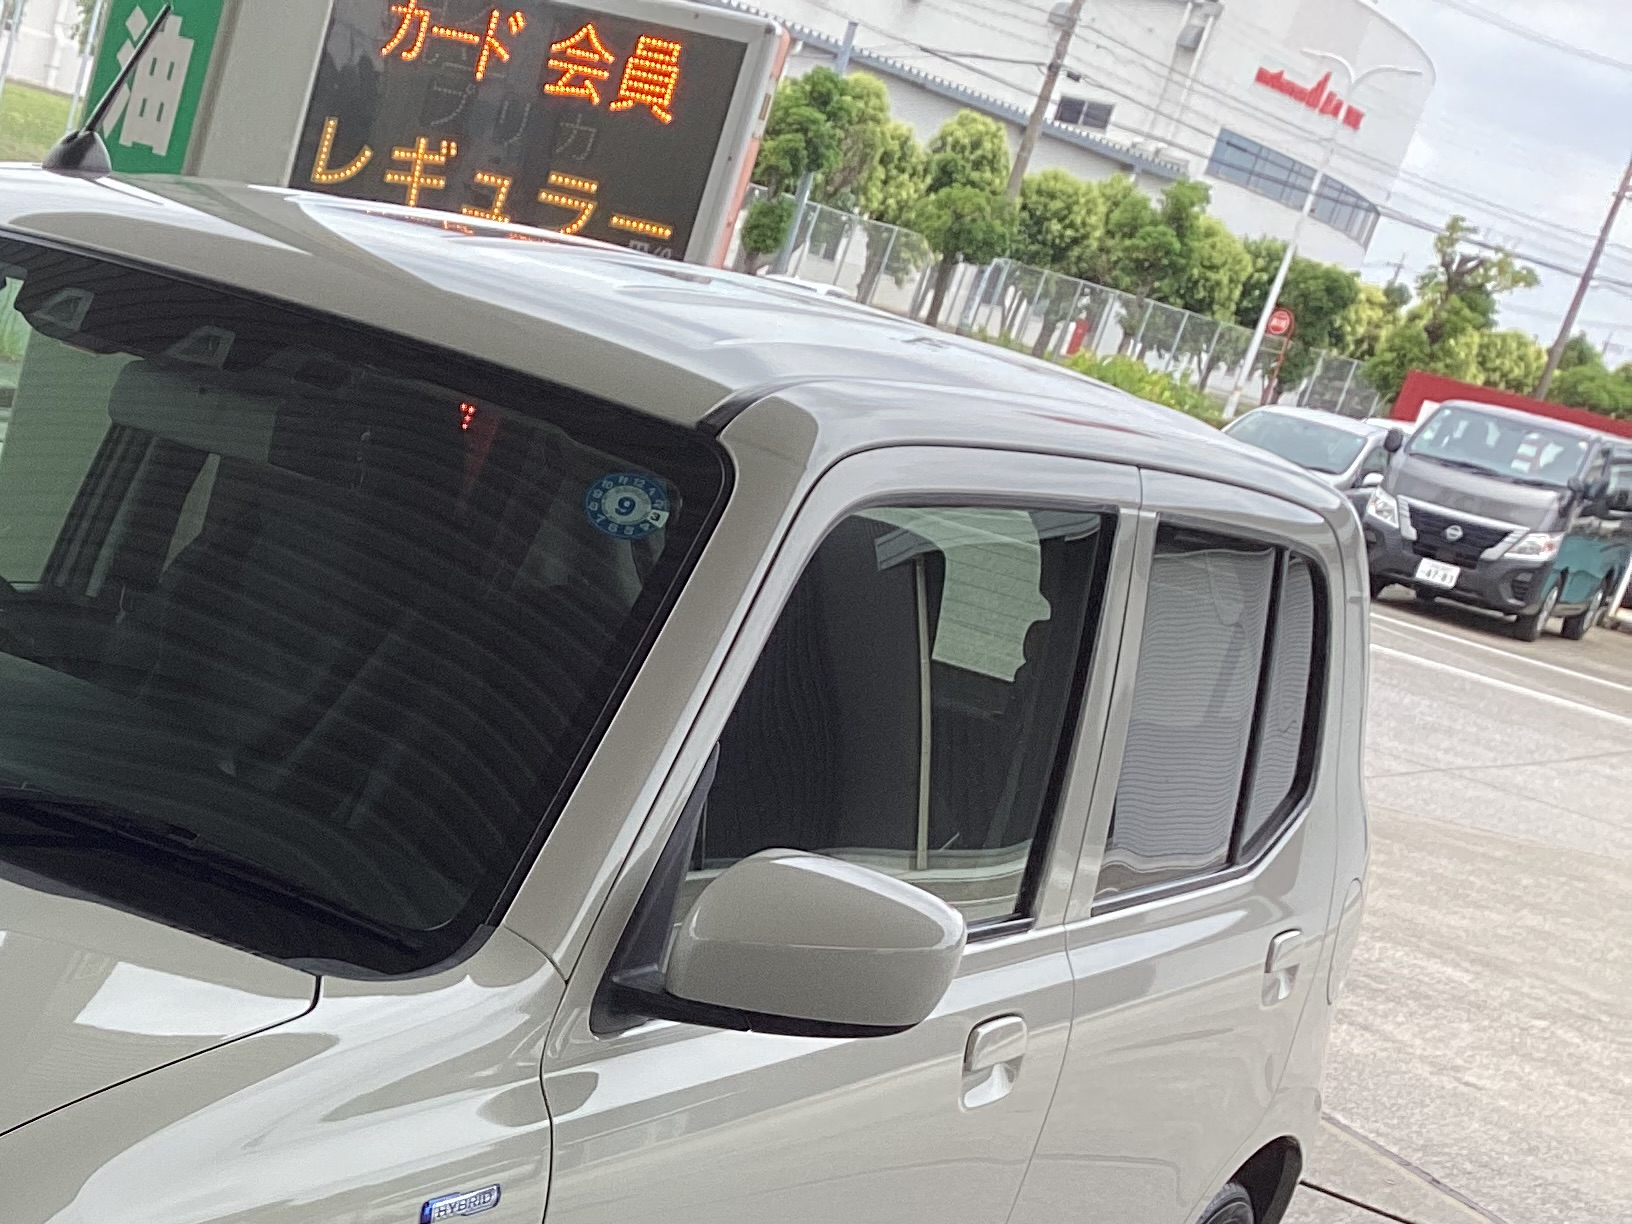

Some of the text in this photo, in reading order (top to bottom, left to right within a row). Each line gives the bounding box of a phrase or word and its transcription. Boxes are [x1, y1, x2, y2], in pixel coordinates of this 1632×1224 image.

[102, 4, 195, 157] 油
[380, 0, 683, 125] カード 会員
[311, 116, 672, 239] レギュラー
[615, 496, 636, 516] 9
[436, 1190, 494, 1218] HYBRID
